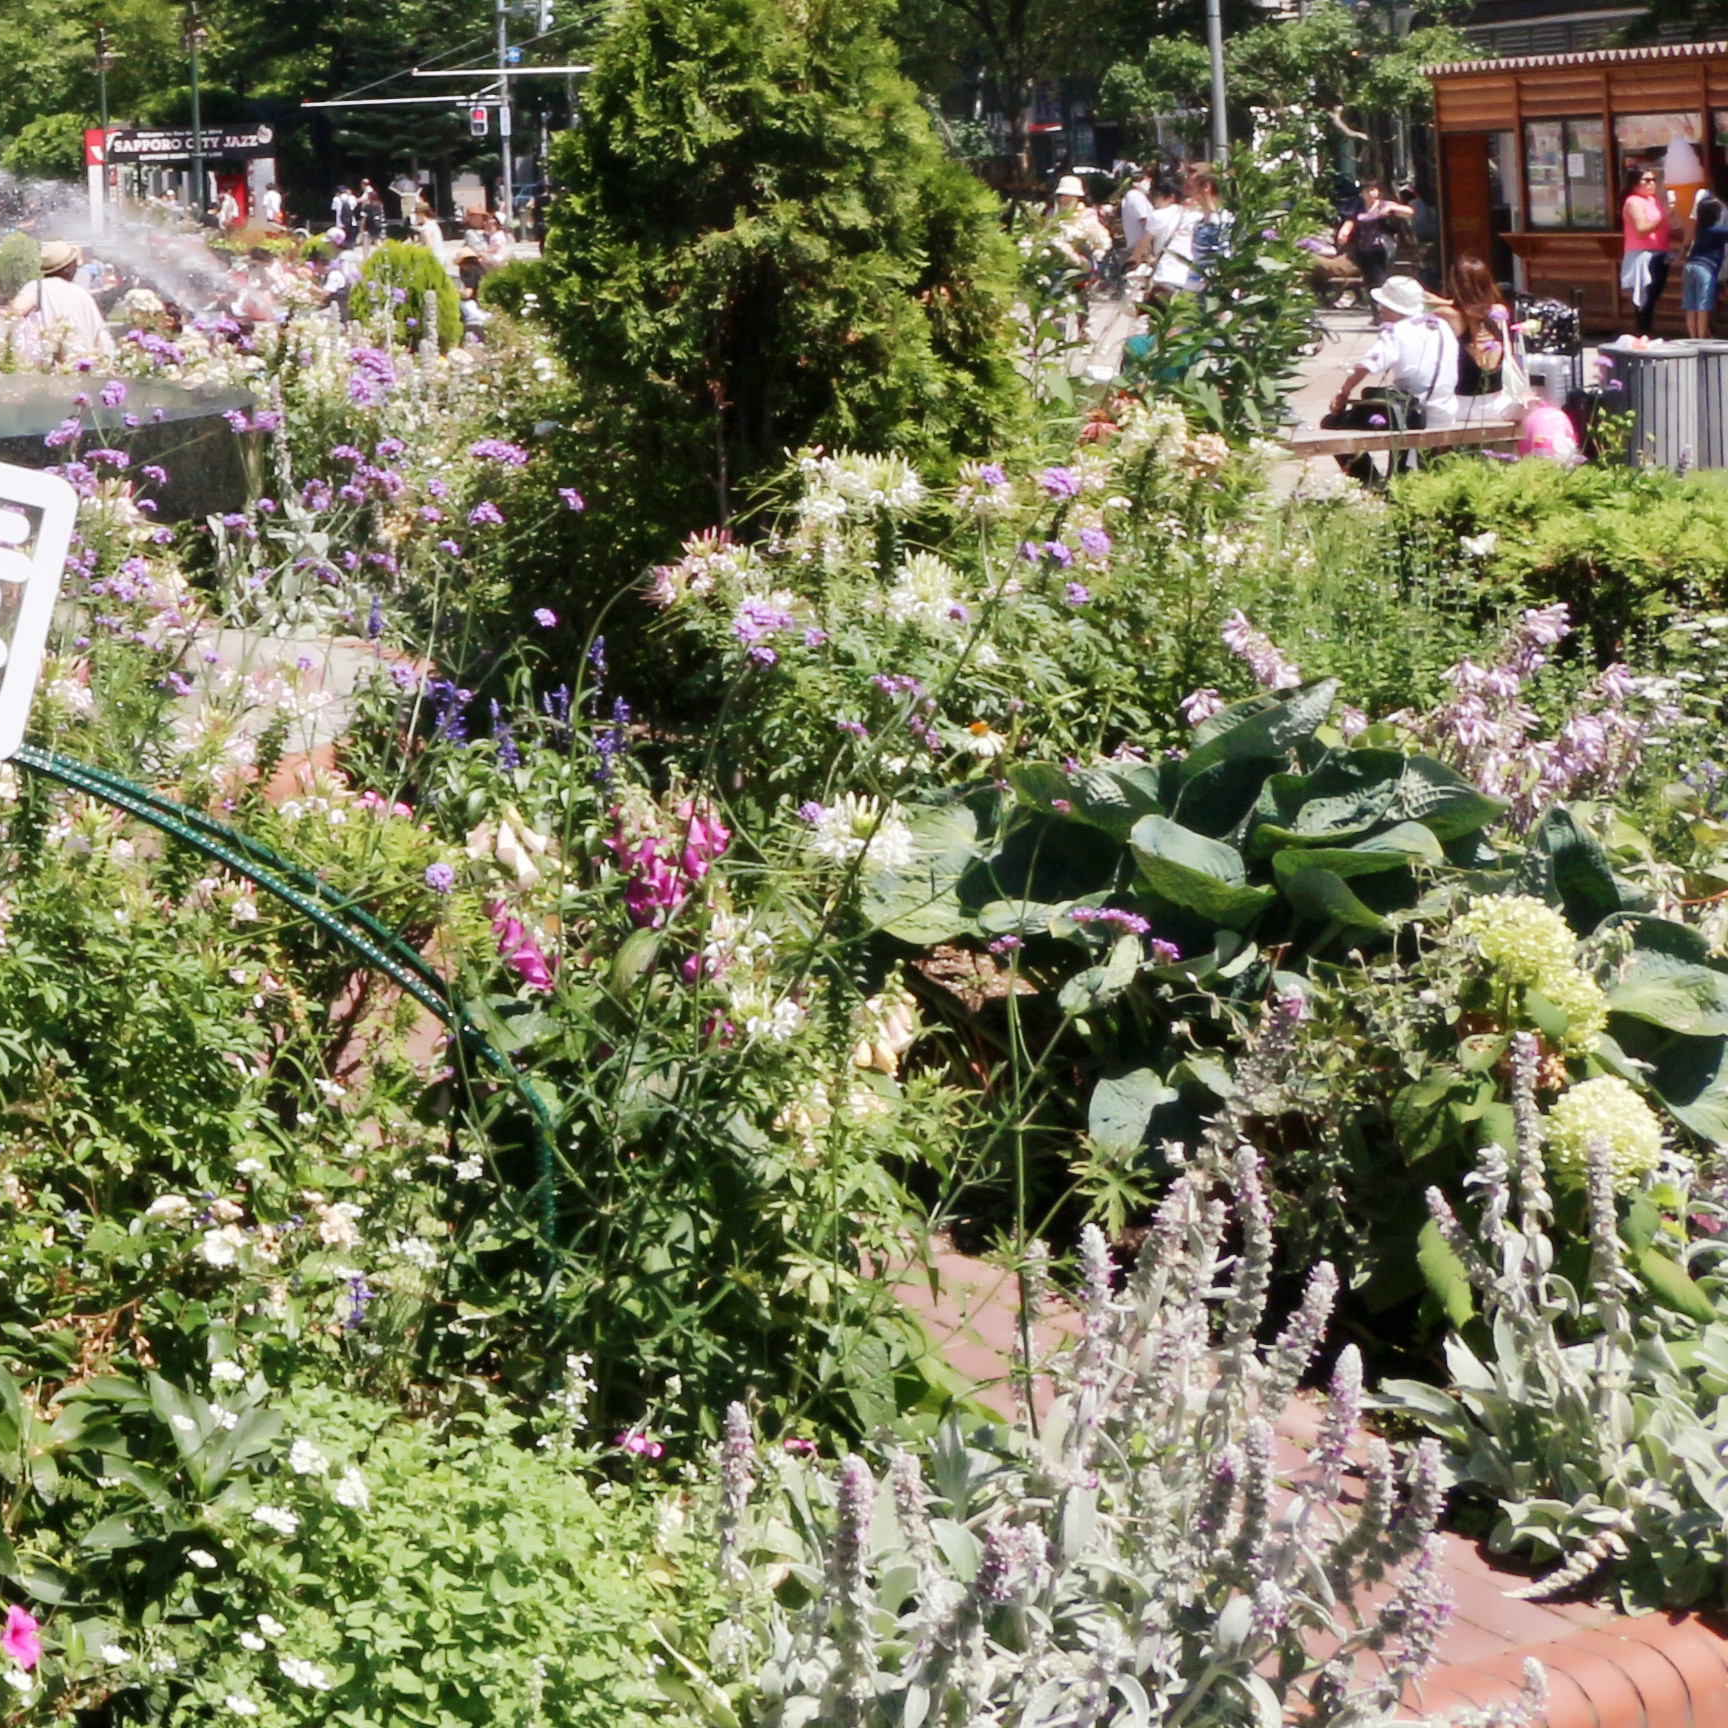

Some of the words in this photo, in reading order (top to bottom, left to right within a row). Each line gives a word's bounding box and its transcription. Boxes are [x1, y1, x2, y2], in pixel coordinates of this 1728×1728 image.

[113, 138, 181, 153] SAPPORO
[185, 137, 220, 150] CTY
[223, 134, 258, 148] JAZZ
